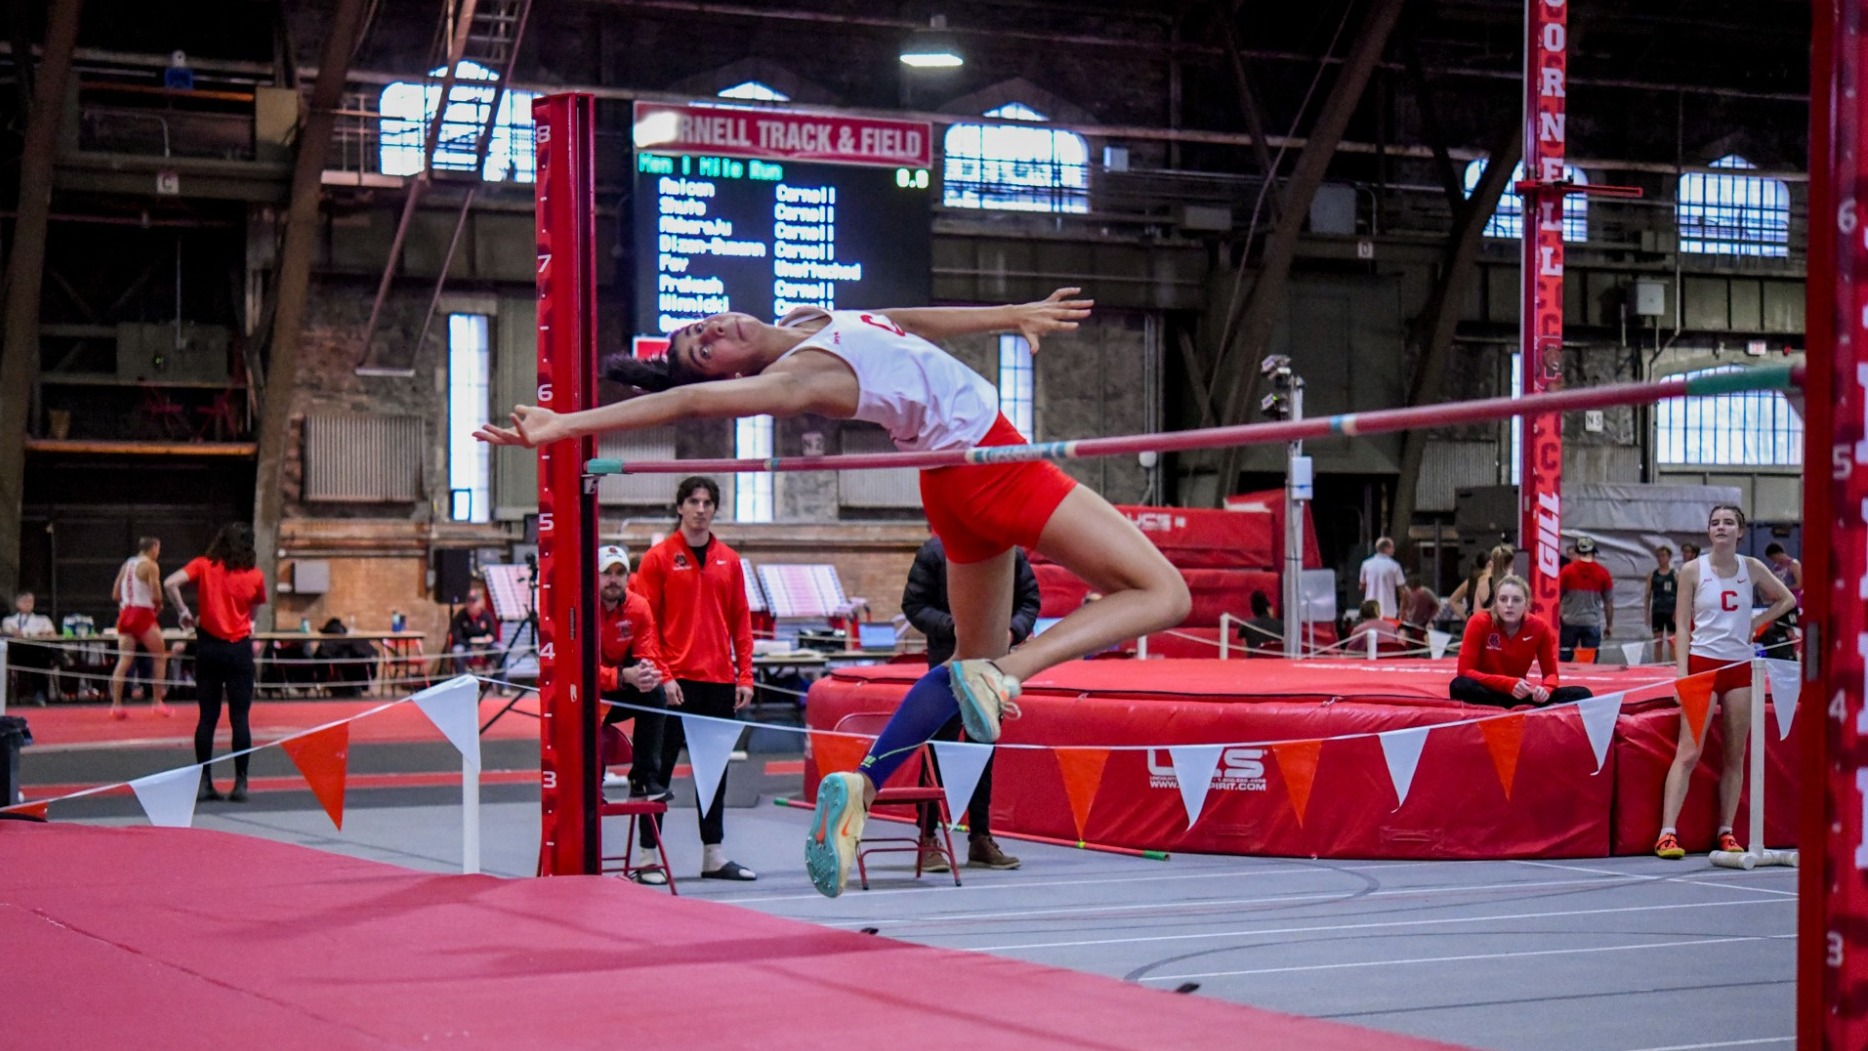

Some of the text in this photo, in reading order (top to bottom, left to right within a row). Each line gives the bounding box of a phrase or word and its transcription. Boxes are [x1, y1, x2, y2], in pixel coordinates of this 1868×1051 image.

[537, 125, 551, 144] 8
[664, 113, 922, 158] RNELL TRACK & FIELD
[1539, 0, 1566, 276] ORNELL
[699, 156, 743, 178] Mile
[775, 184, 835, 204] Cornell
[774, 203, 834, 223] Cornell
[1837, 198, 1857, 233] 6
[774, 221, 834, 242] Cornell
[774, 241, 834, 260] Cornell
[537, 254, 552, 273] 7
[774, 259, 861, 281] Unattached
[774, 279, 834, 299] Cornell
[537, 384, 553, 401] 6
[1832, 444, 1852, 480] 5
[538, 513, 555, 532] 5
[1538, 491, 1560, 578] GILL
[1720, 590, 1739, 612] C
[539, 642, 556, 660] 4
[1828, 689, 1847, 724] 4
[542, 771, 557, 789] 3
[1826, 931, 1844, 967] 3
